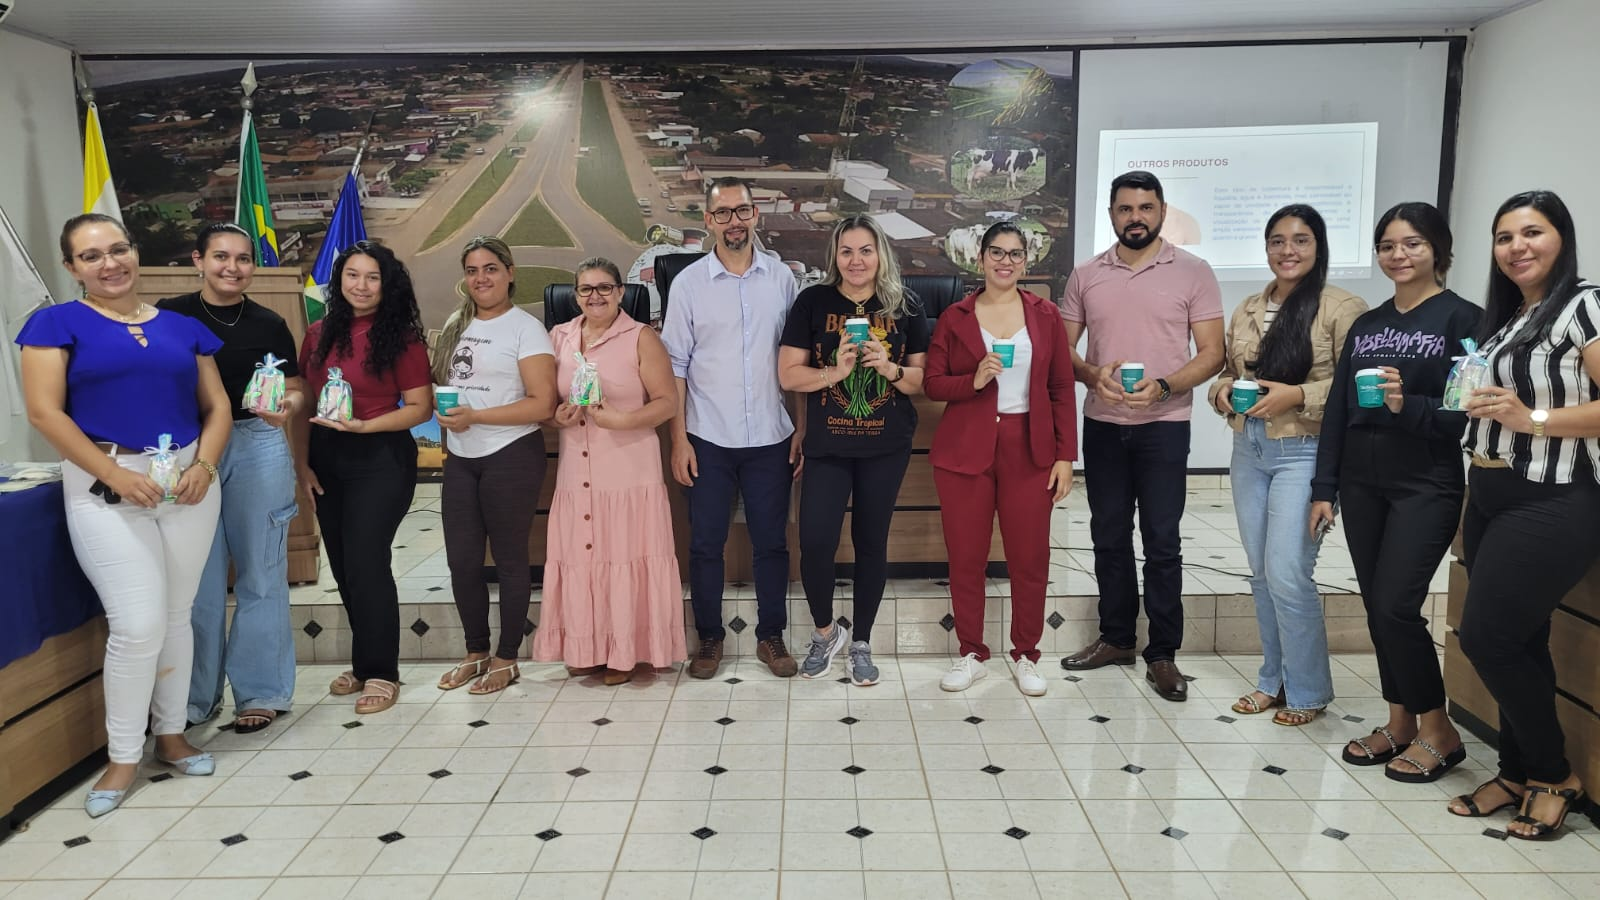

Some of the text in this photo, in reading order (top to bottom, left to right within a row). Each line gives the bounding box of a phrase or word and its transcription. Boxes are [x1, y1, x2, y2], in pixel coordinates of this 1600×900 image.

[1127, 158, 1229, 169] OUTROS PRODUTOS
[855, 416, 885, 428] Tropical
